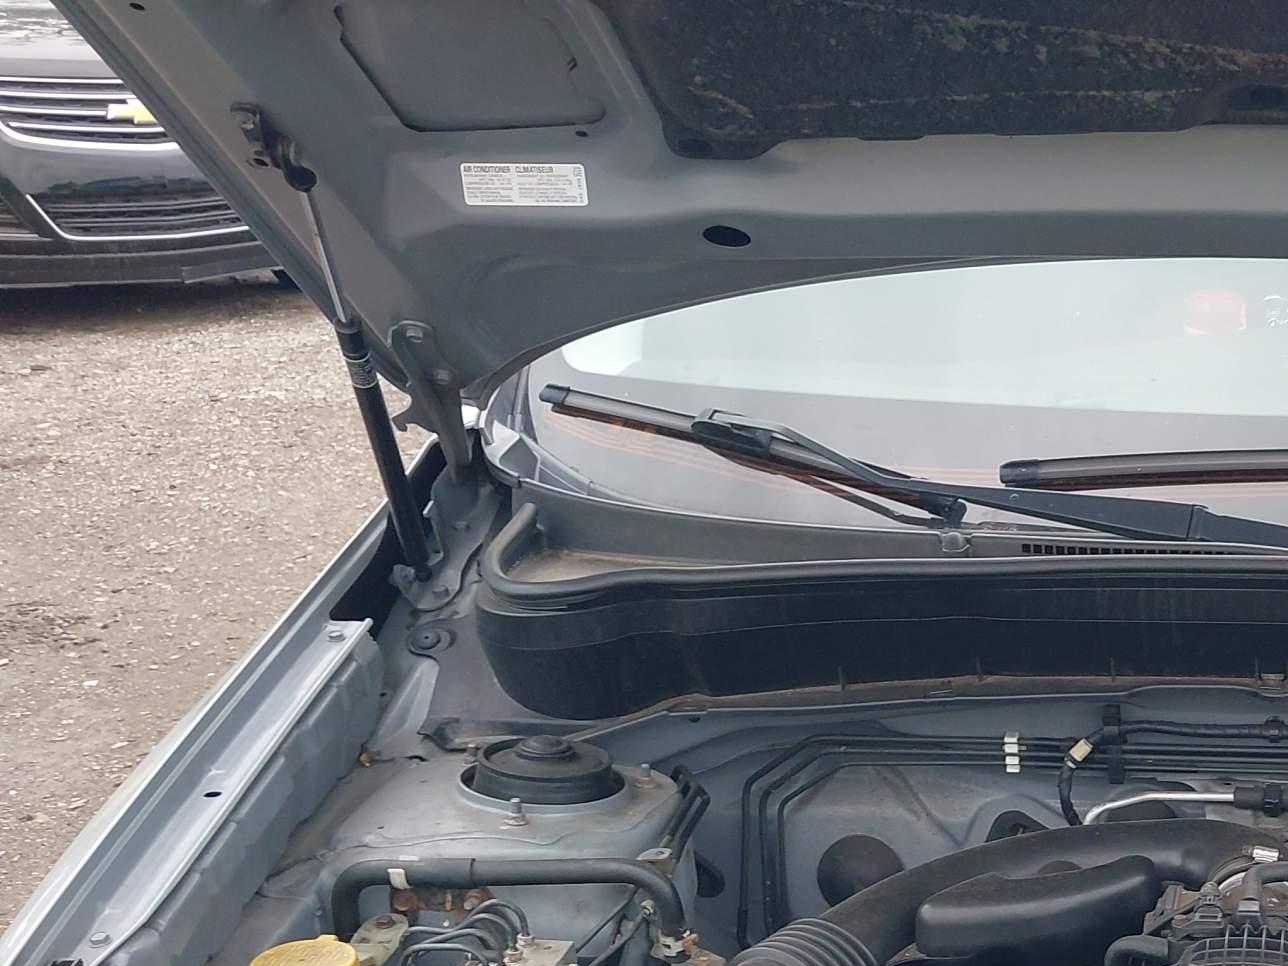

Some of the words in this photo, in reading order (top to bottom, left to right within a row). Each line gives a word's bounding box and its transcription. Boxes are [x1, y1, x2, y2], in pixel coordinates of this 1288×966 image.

[463, 165, 472, 173] AIR
[473, 165, 511, 174] CONDITIONER
[515, 166, 553, 174] CLIMATISEUR
